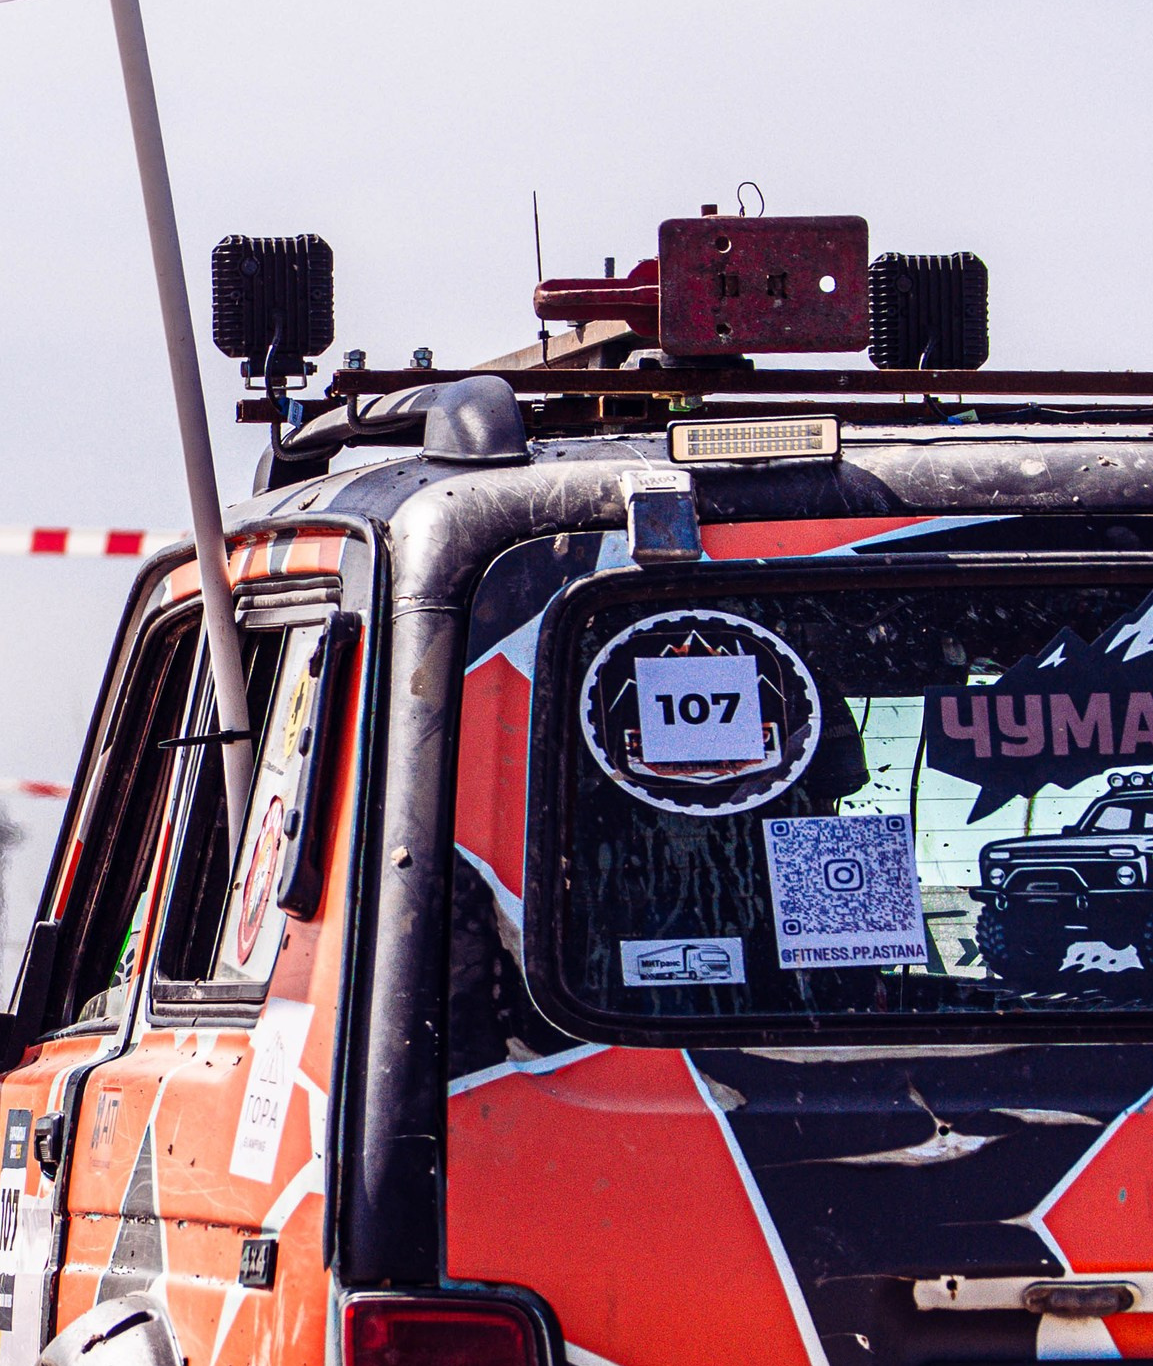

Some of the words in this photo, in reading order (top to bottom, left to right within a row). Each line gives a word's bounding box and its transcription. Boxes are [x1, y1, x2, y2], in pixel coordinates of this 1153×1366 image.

[655, 692, 741, 725] 107
[244, 1094, 279, 1129] ГОРА
[0, 1188, 20, 1252] 107
